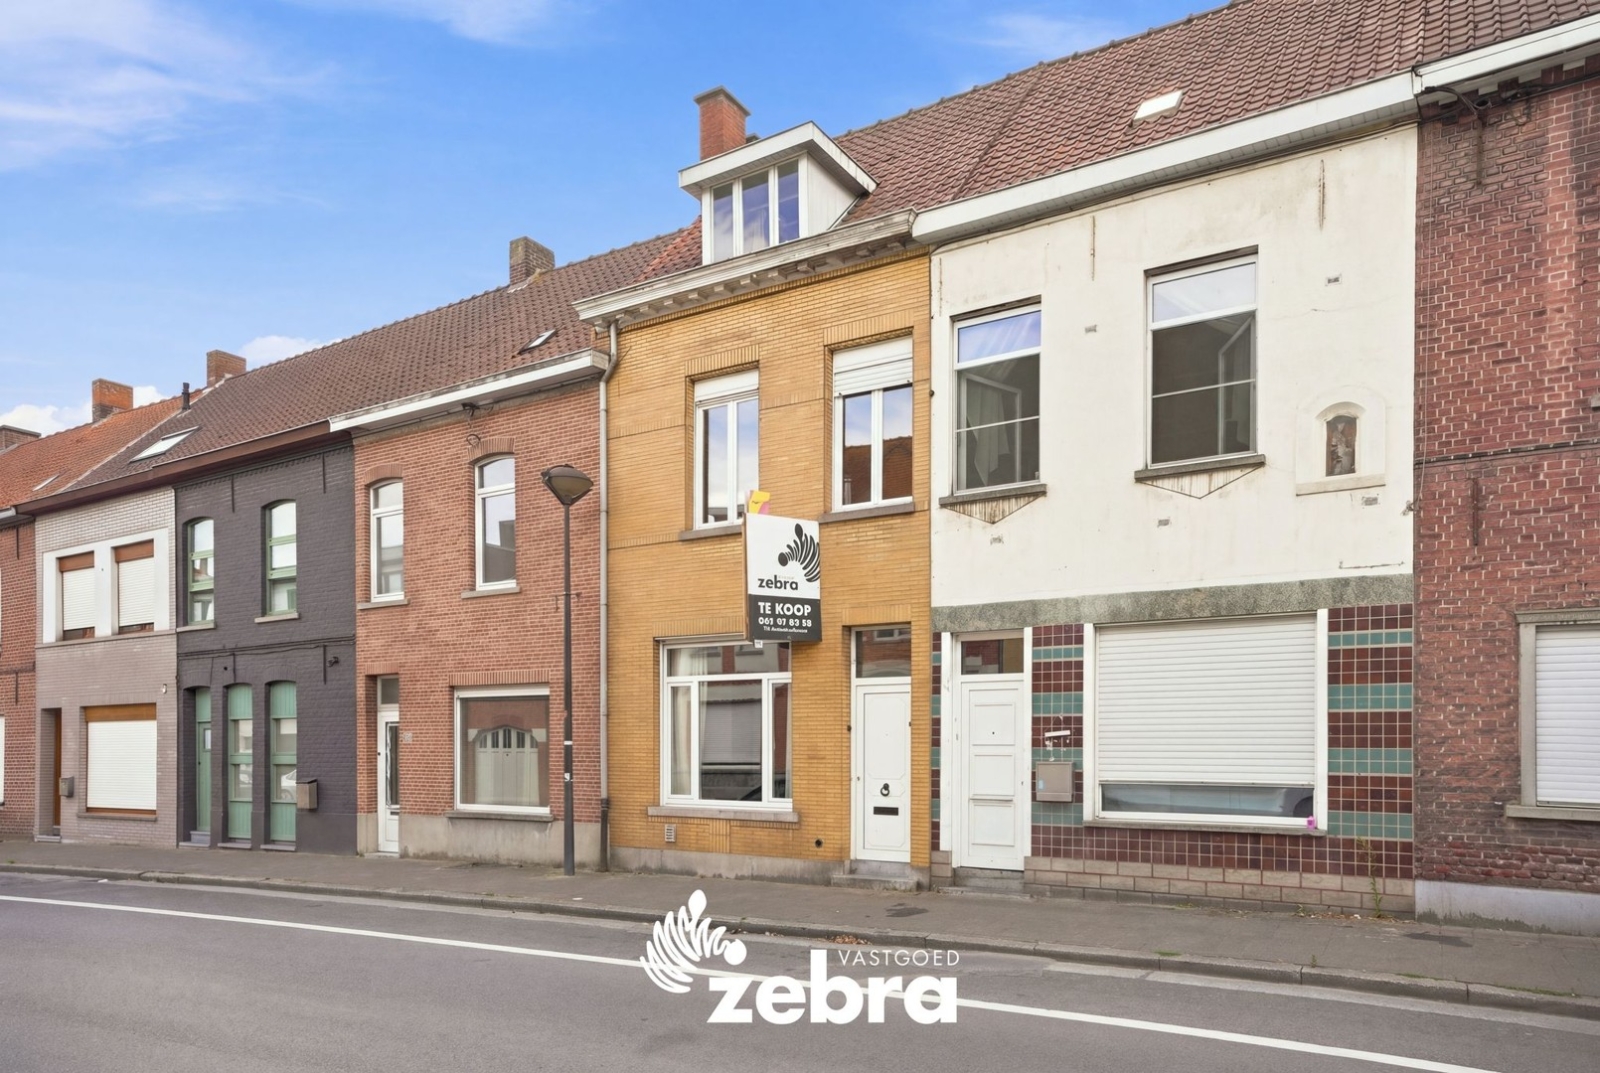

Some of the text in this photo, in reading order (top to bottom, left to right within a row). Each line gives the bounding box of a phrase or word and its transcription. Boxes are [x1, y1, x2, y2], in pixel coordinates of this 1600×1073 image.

[758, 574, 798, 590] zebra
[758, 602, 811, 616] TE KOOP
